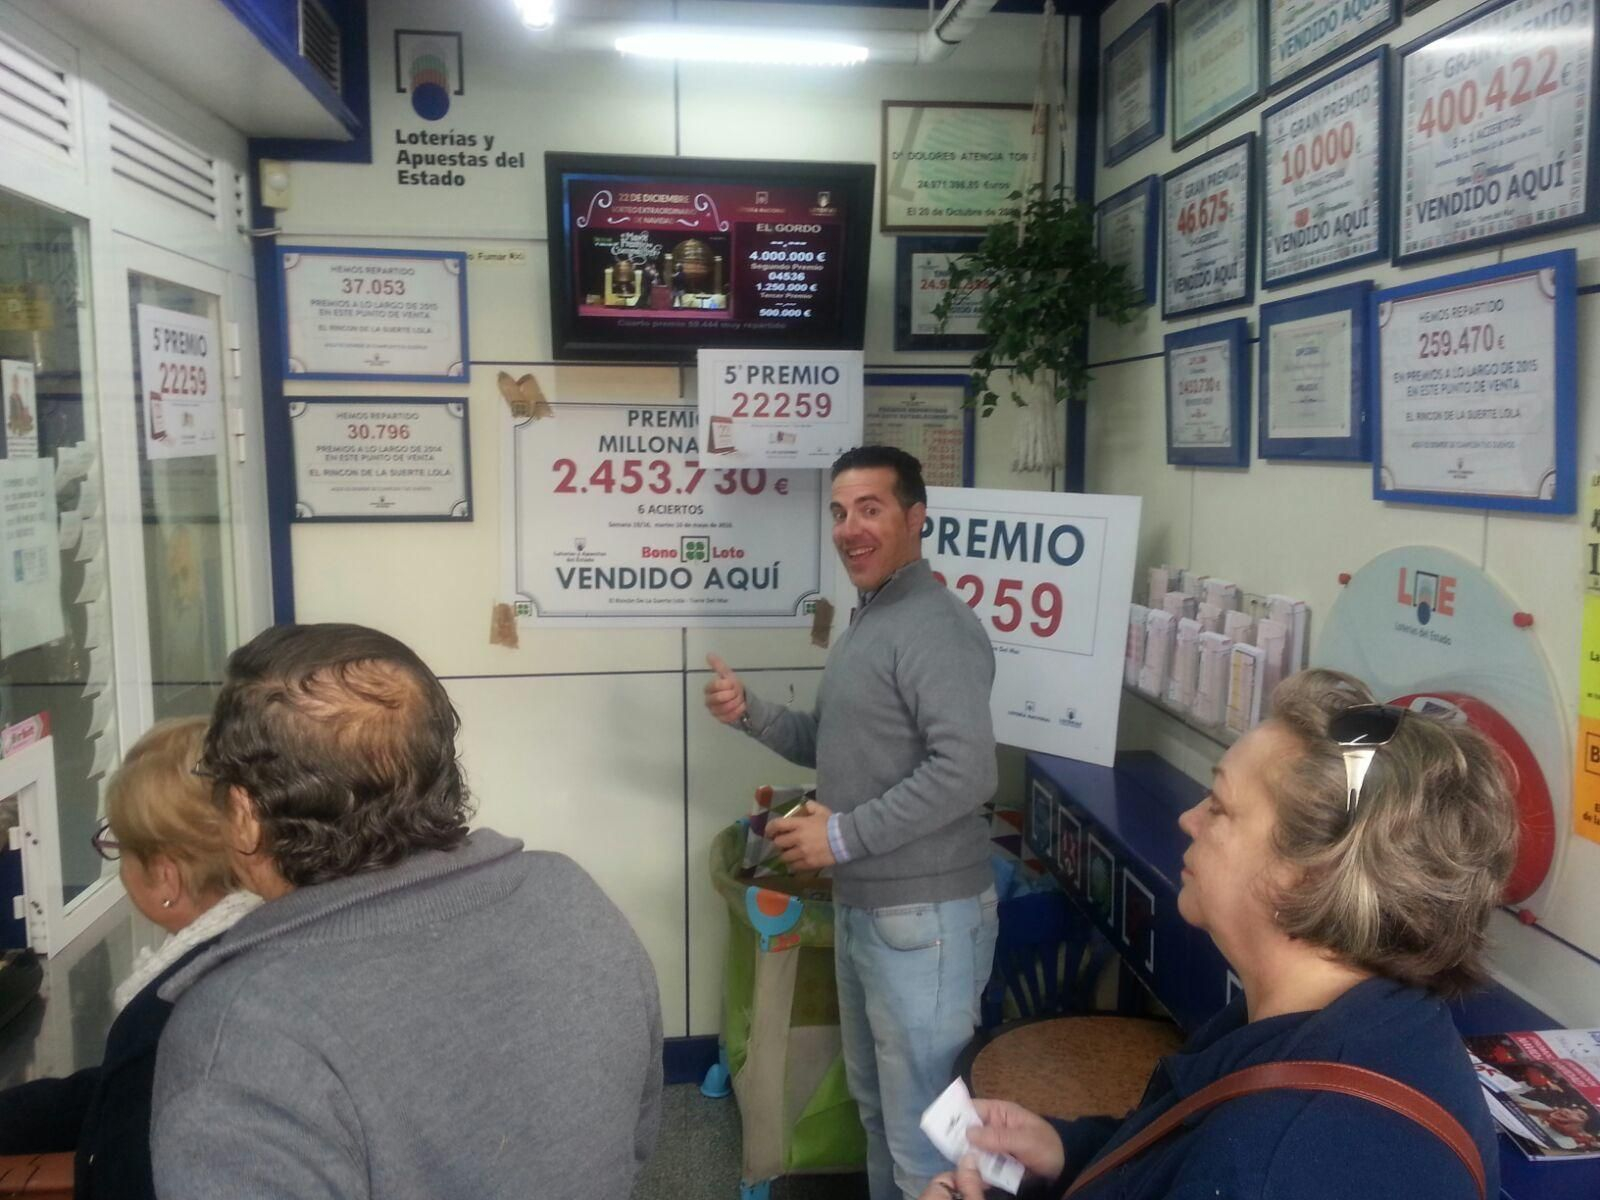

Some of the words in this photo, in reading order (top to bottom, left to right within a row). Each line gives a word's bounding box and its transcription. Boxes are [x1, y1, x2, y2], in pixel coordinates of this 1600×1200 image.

[1417, 45, 1559, 138] 400.422
[1561, 61, 1572, 87] €
[1289, 113, 1321, 139] GRAN
[1323, 85, 1371, 120] PREMIO
[396, 129, 477, 147] Loterías
[483, 135, 495, 151] y
[396, 150, 488, 169] Apuestas
[495, 152, 525, 168] del
[907, 152, 956, 161] DOLORES
[961, 152, 1003, 162] ATENCIA
[1281, 121, 1355, 185] 10.000
[397, 170, 466, 187] Estado
[1184, 180, 1206, 200] GRAN
[1207, 162, 1240, 187] PREMIO
[1416, 179, 1502, 224] VENDIDO
[1506, 150, 1566, 201] AQUÍ
[630, 193, 642, 202] DE
[642, 193, 691, 204] DICIEMBRE
[945, 208, 982, 217] Octubre
[756, 223, 772, 232] EL
[775, 223, 822, 233] GORDO
[1274, 219, 1330, 255] VENDIDO
[1333, 198, 1370, 238] AQUÍ
[749, 251, 815, 262] 4.000.000
[816, 251, 828, 262] €
[331, 265, 363, 274] HEMOS
[365, 266, 415, 275] REPARTIDO
[341, 278, 406, 296] 37.053
[809, 283, 819, 292] €
[310, 299, 349, 308] PREMIOS
[374, 301, 404, 309] LARGO
[406, 302, 417, 310] DE
[759, 308, 802, 317] 500.000
[803, 309, 813, 317] €
[1419, 307, 1450, 324] HEMOS
[1451, 299, 1505, 320] REPARTIDO
[319, 308, 332, 317] EN
[333, 308, 353, 317] ESTE
[355, 309, 386, 318] PUNTO
[388, 310, 399, 318] DE
[402, 310, 431, 319] VENTA
[164, 328, 208, 358] PREMIO
[1418, 323, 1495, 359] 259.470
[1497, 334, 1505, 351] €
[746, 364, 840, 385] PREMIO
[1501, 361, 1514, 374] DE
[159, 361, 208, 395] 22259
[1473, 379, 1486, 393] DE
[1488, 378, 1520, 392] VENTA
[731, 391, 832, 419] 22259
[336, 412, 369, 420] HEMOS
[370, 412, 420, 421] REPARTIDO
[628, 409, 698, 429] PREMI
[347, 424, 411, 440] 30.796
[316, 445, 356, 453] PREMIOS
[361, 454, 391, 462] PUNTO
[393, 454, 404, 462] DE
[309, 469, 320, 477] EL
[360, 469, 373, 477] DE
[375, 469, 388, 477] LA
[390, 469, 425, 477] SUERTE
[427, 469, 452, 477] LOLA
[551, 458, 768, 495] 2.453.730
[774, 477, 790, 495] €
[637, 504, 646, 515] 6
[648, 504, 704, 515] ACIERTOS
[641, 546, 678, 559] Bono
[712, 547, 745, 559] Loto
[555, 566, 693, 590] VENDIDO
[703, 561, 780, 592] AQUÍ
[932, 570, 1063, 638] 259
